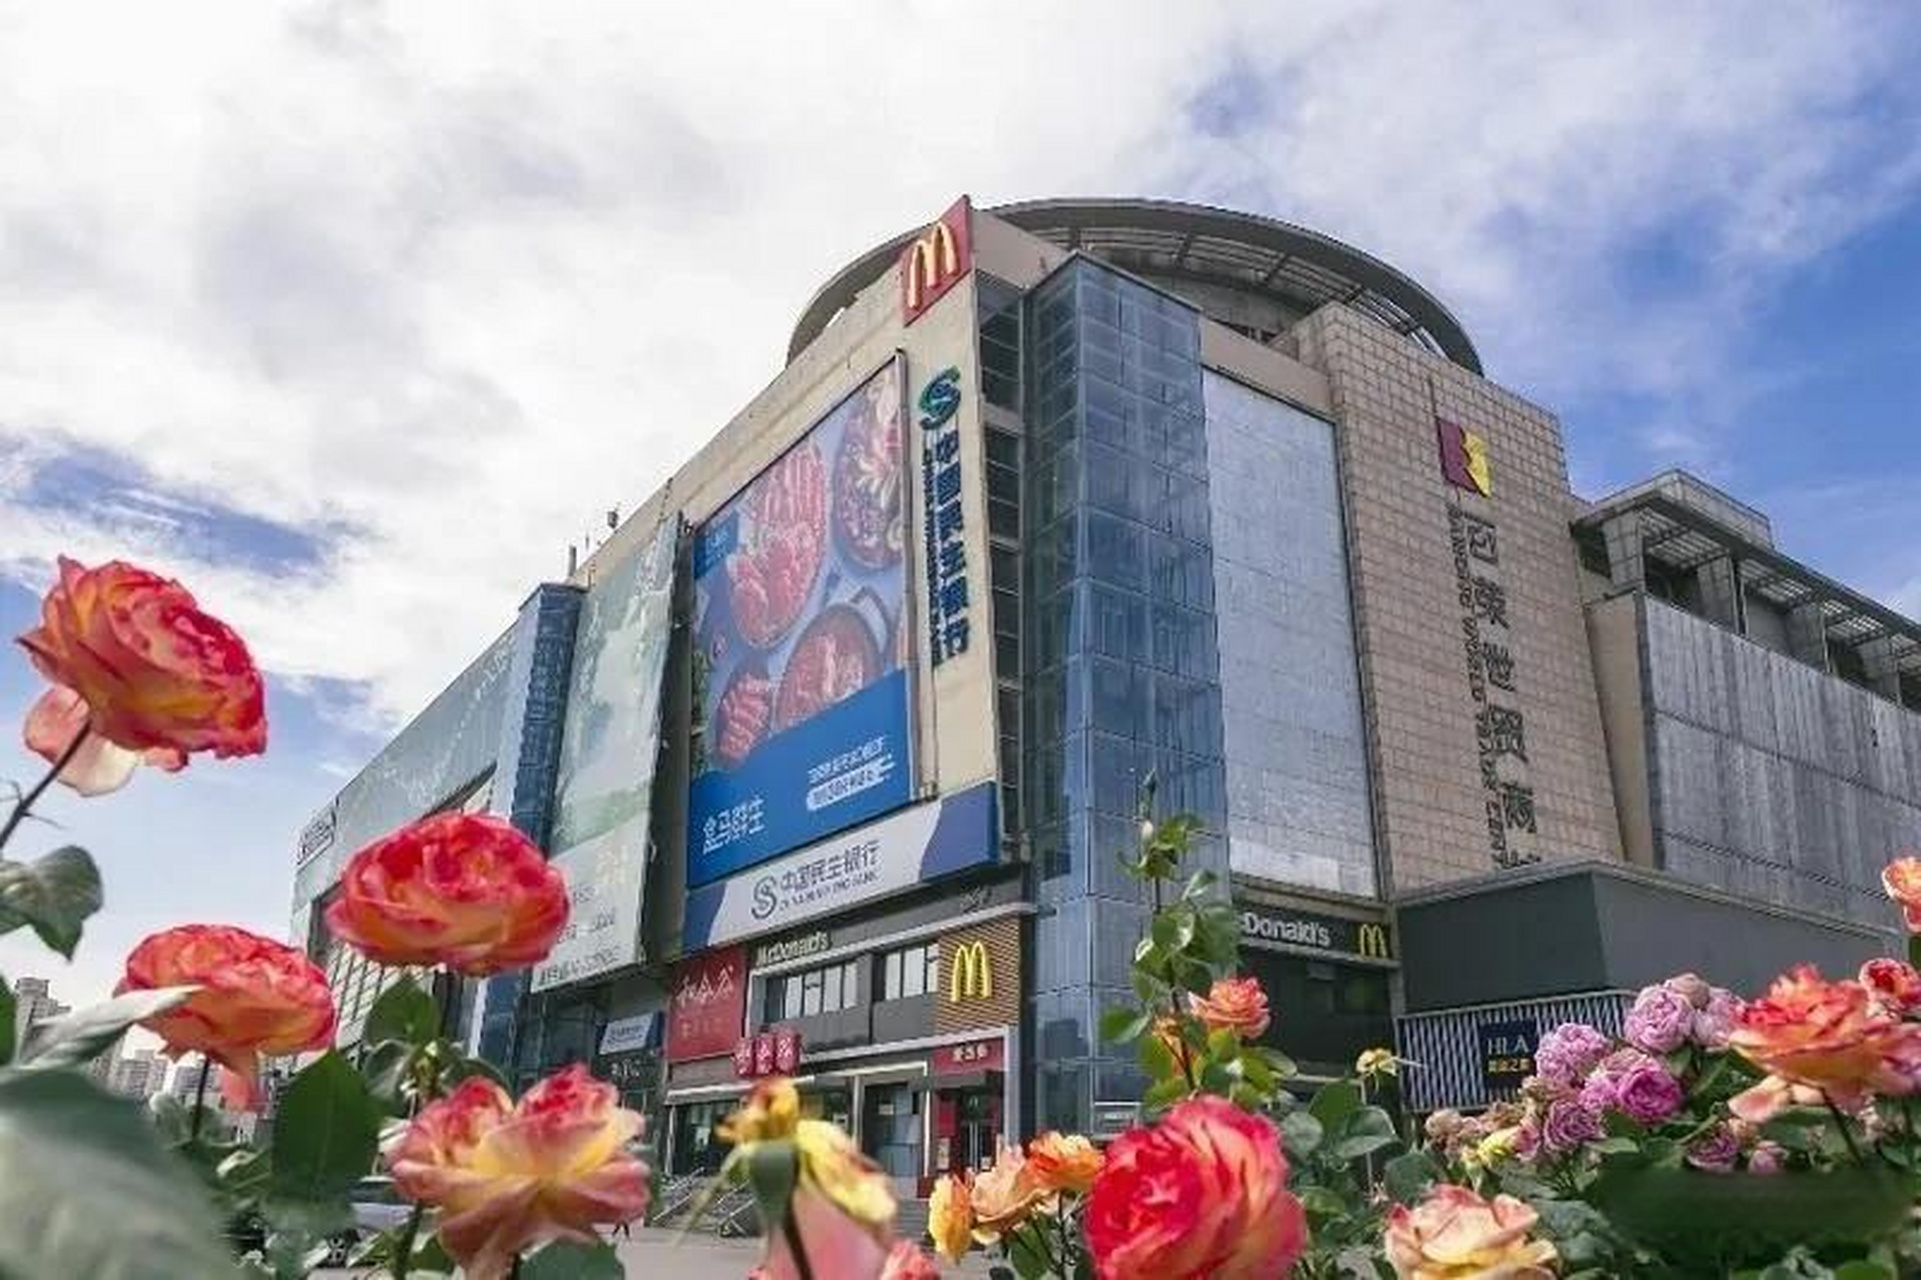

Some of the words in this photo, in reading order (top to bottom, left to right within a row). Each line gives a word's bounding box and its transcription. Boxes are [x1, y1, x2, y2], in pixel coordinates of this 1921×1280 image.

[780, 840, 880, 892] 中国民生银行
[1487, 1035, 1530, 1056] HLA
